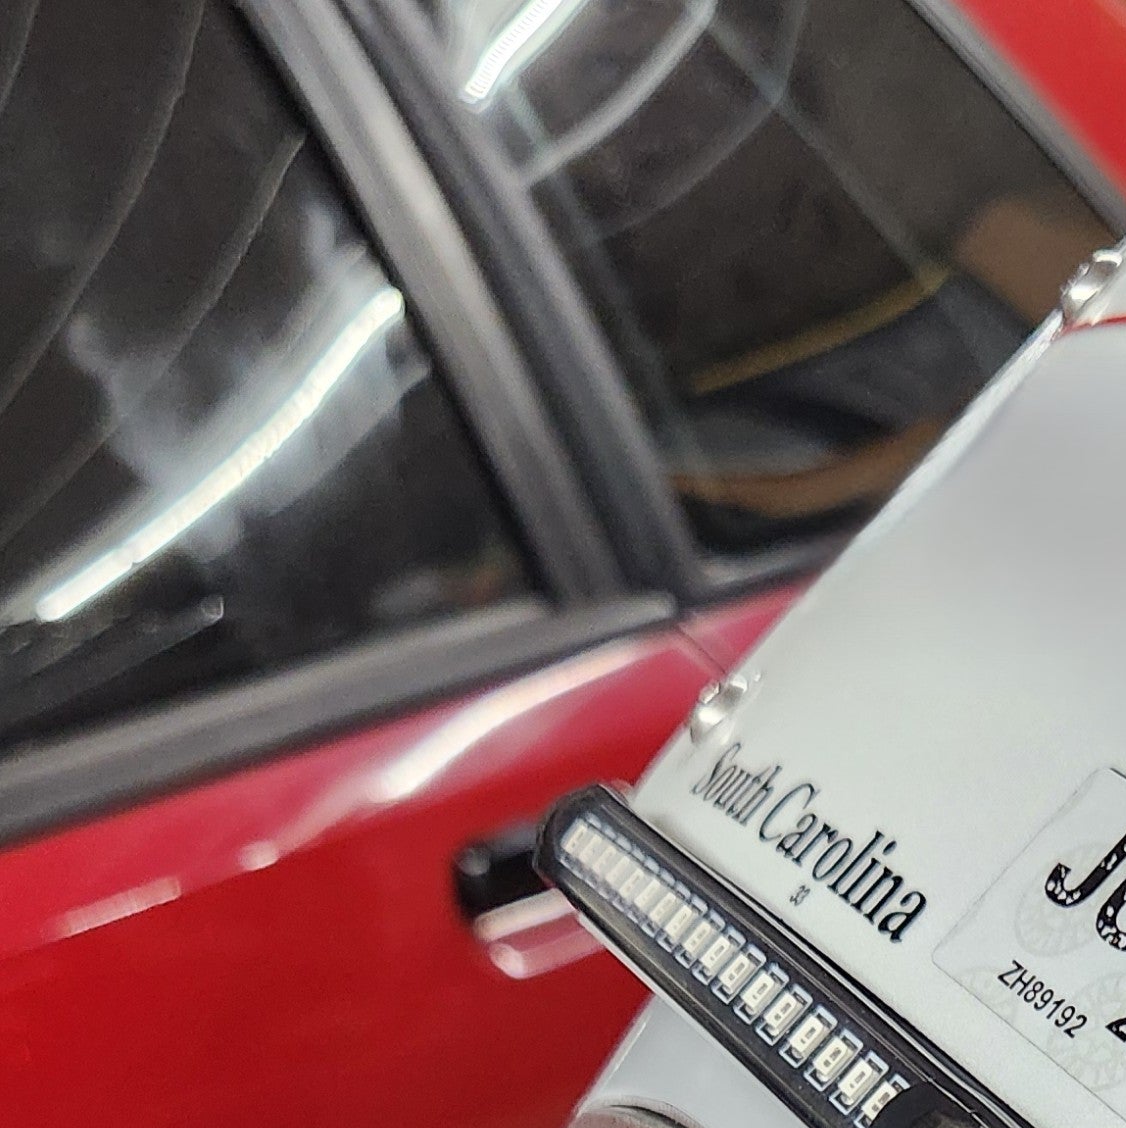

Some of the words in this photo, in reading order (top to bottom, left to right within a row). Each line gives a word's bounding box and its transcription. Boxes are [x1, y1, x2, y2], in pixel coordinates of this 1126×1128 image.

[692, 742, 782, 826] South
[759, 783, 926, 943] Carolina
[997, 960, 1087, 1038] ZH89192
